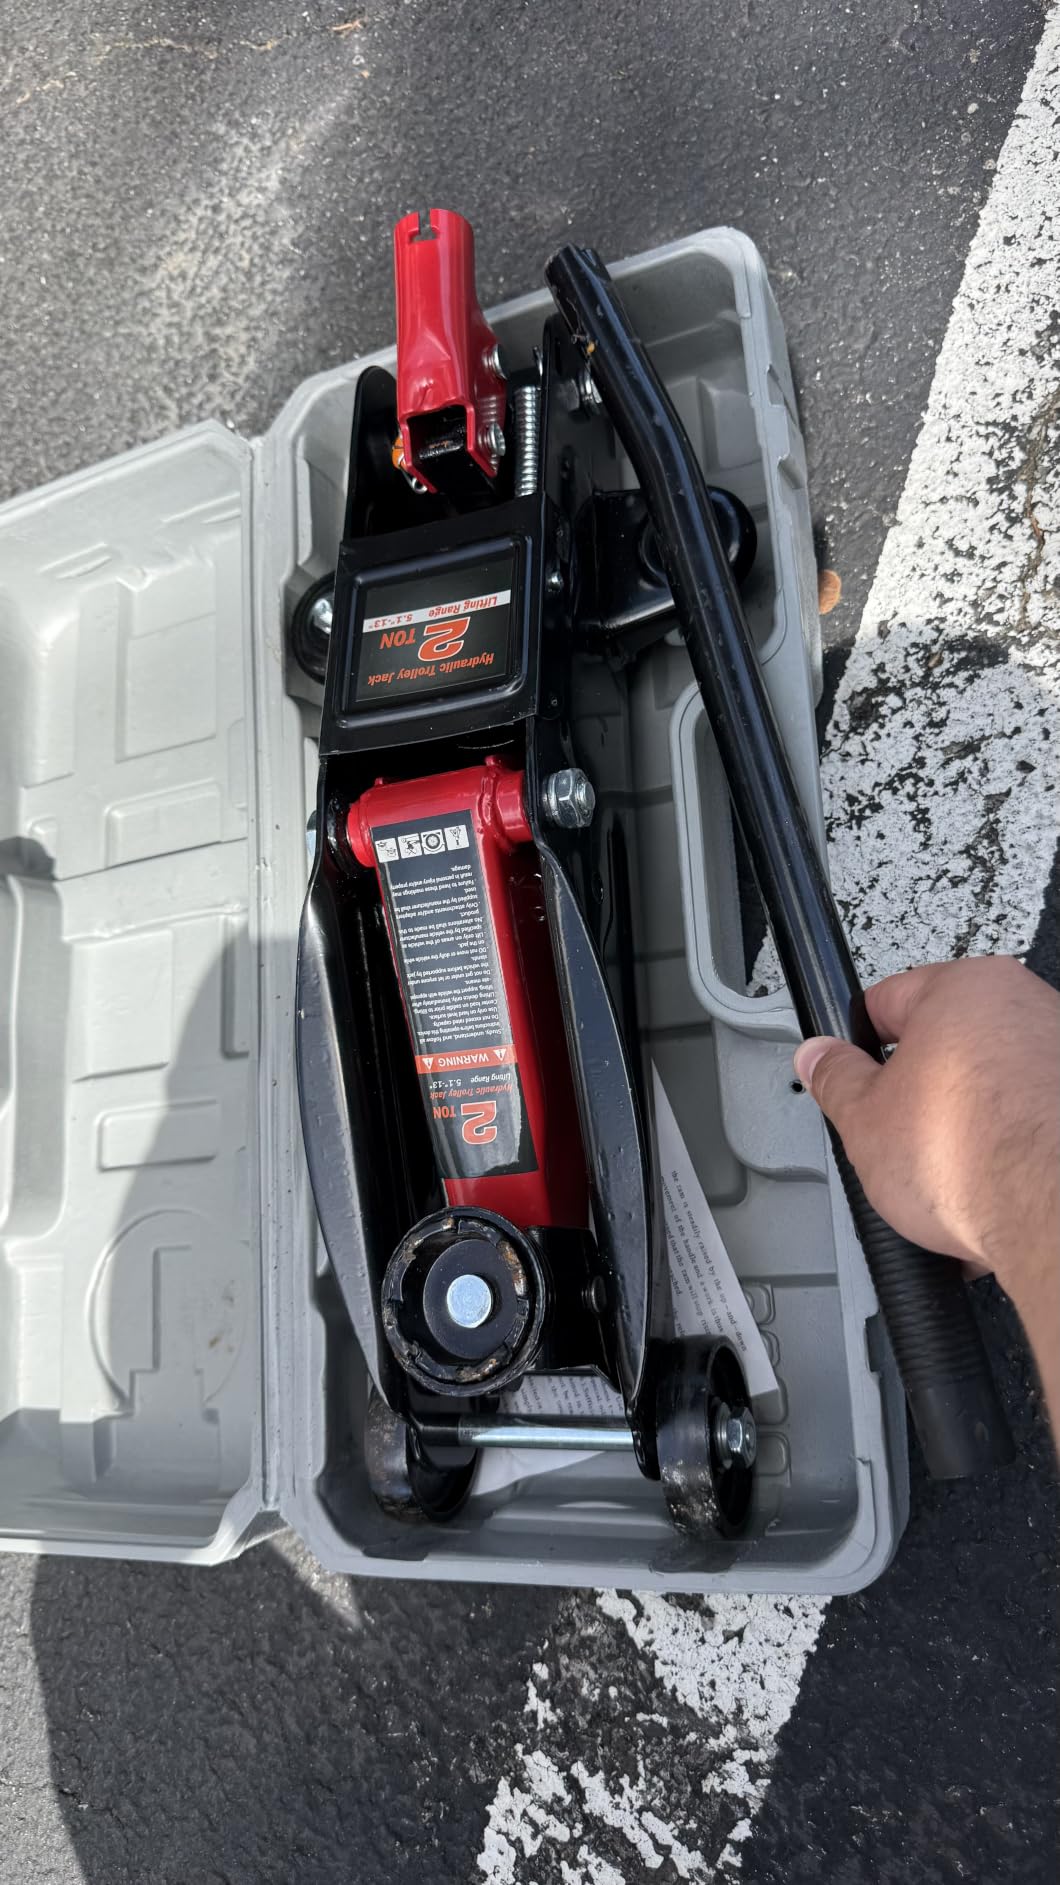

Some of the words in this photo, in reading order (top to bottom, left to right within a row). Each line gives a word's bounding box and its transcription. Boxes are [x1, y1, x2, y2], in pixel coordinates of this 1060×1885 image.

[429, 604, 460, 617] Range
[464, 596, 497, 611] Lifting
[379, 628, 416, 649] TON
[418, 616, 471, 661] 2
[440, 653, 495, 672] Hydraulic
[396, 664, 435, 679] Trolley
[368, 672, 395, 686] Jack
[438, 1053, 489, 1066] WARNING
[430, 1091, 445, 1099] Jack
[448, 1088, 473, 1097] Trolley
[476, 1084, 512, 1094] Hydraulic
[433, 1105, 456, 1118] TON
[461, 1101, 497, 1144] 2
